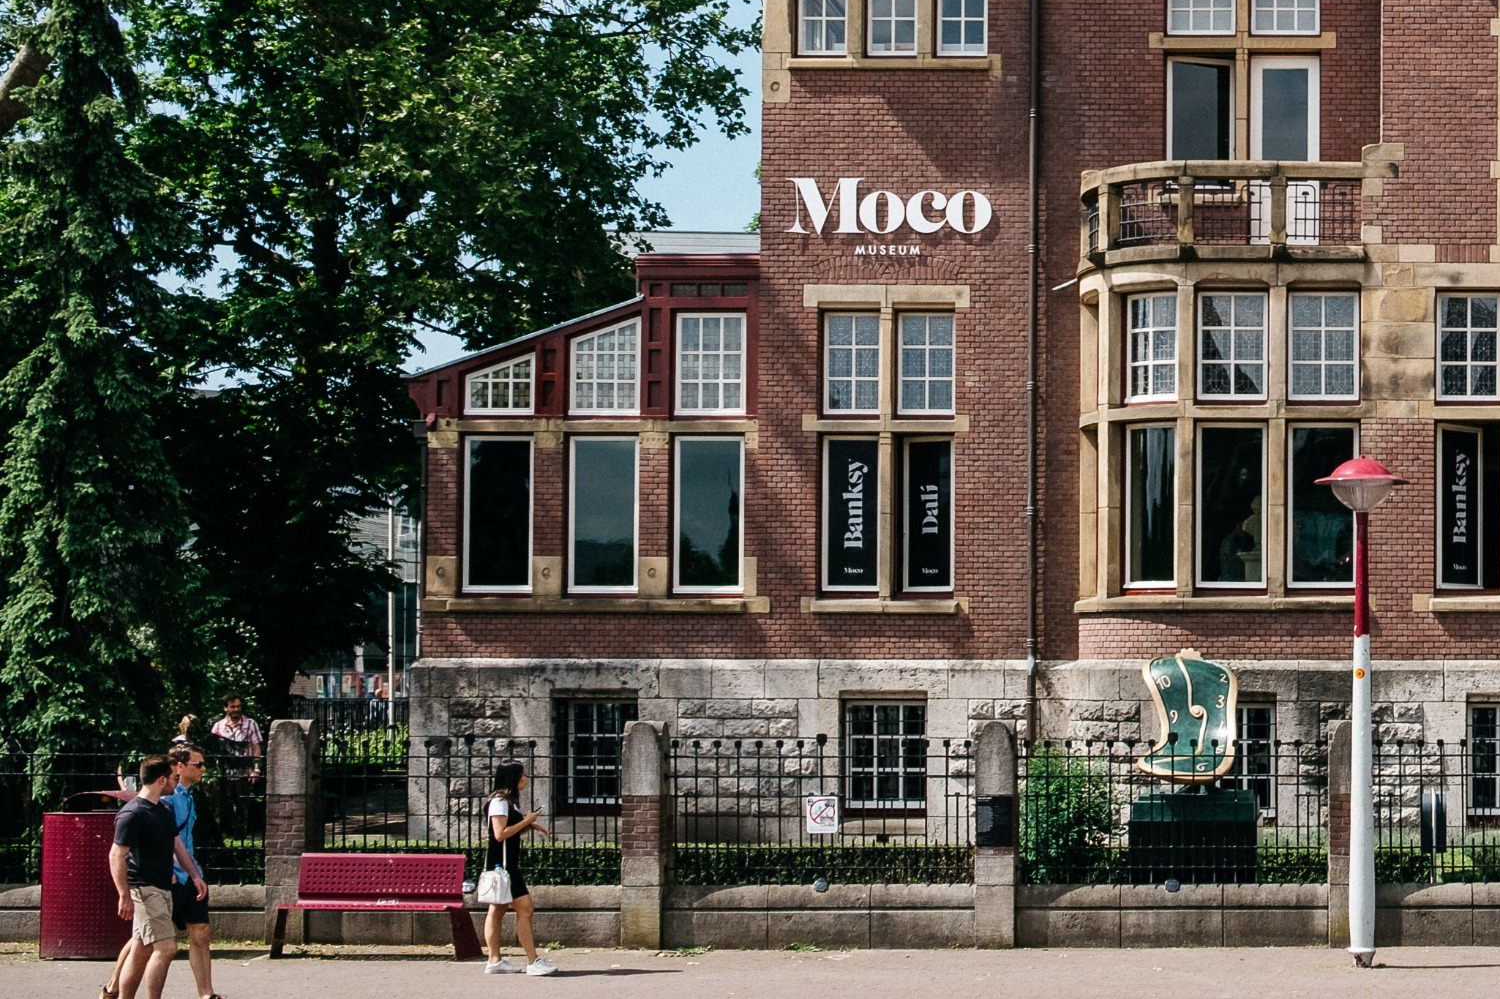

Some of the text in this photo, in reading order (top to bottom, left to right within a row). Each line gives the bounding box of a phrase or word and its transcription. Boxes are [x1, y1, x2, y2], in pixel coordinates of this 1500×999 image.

[784, 177, 993, 235] Moco
[855, 244, 921, 256] MUSEUM
[842, 458, 868, 549] Banksy
[1452, 449, 1471, 544] Banksy
[920, 484, 939, 535] Dalí
[843, 566, 864, 574] Moco
[1156, 675, 1171, 690] 10
[1220, 673, 1228, 683] 2
[1216, 695, 1225, 709] 3
[1170, 710, 1179, 724] 9
[1196, 762, 1209, 771] 6
